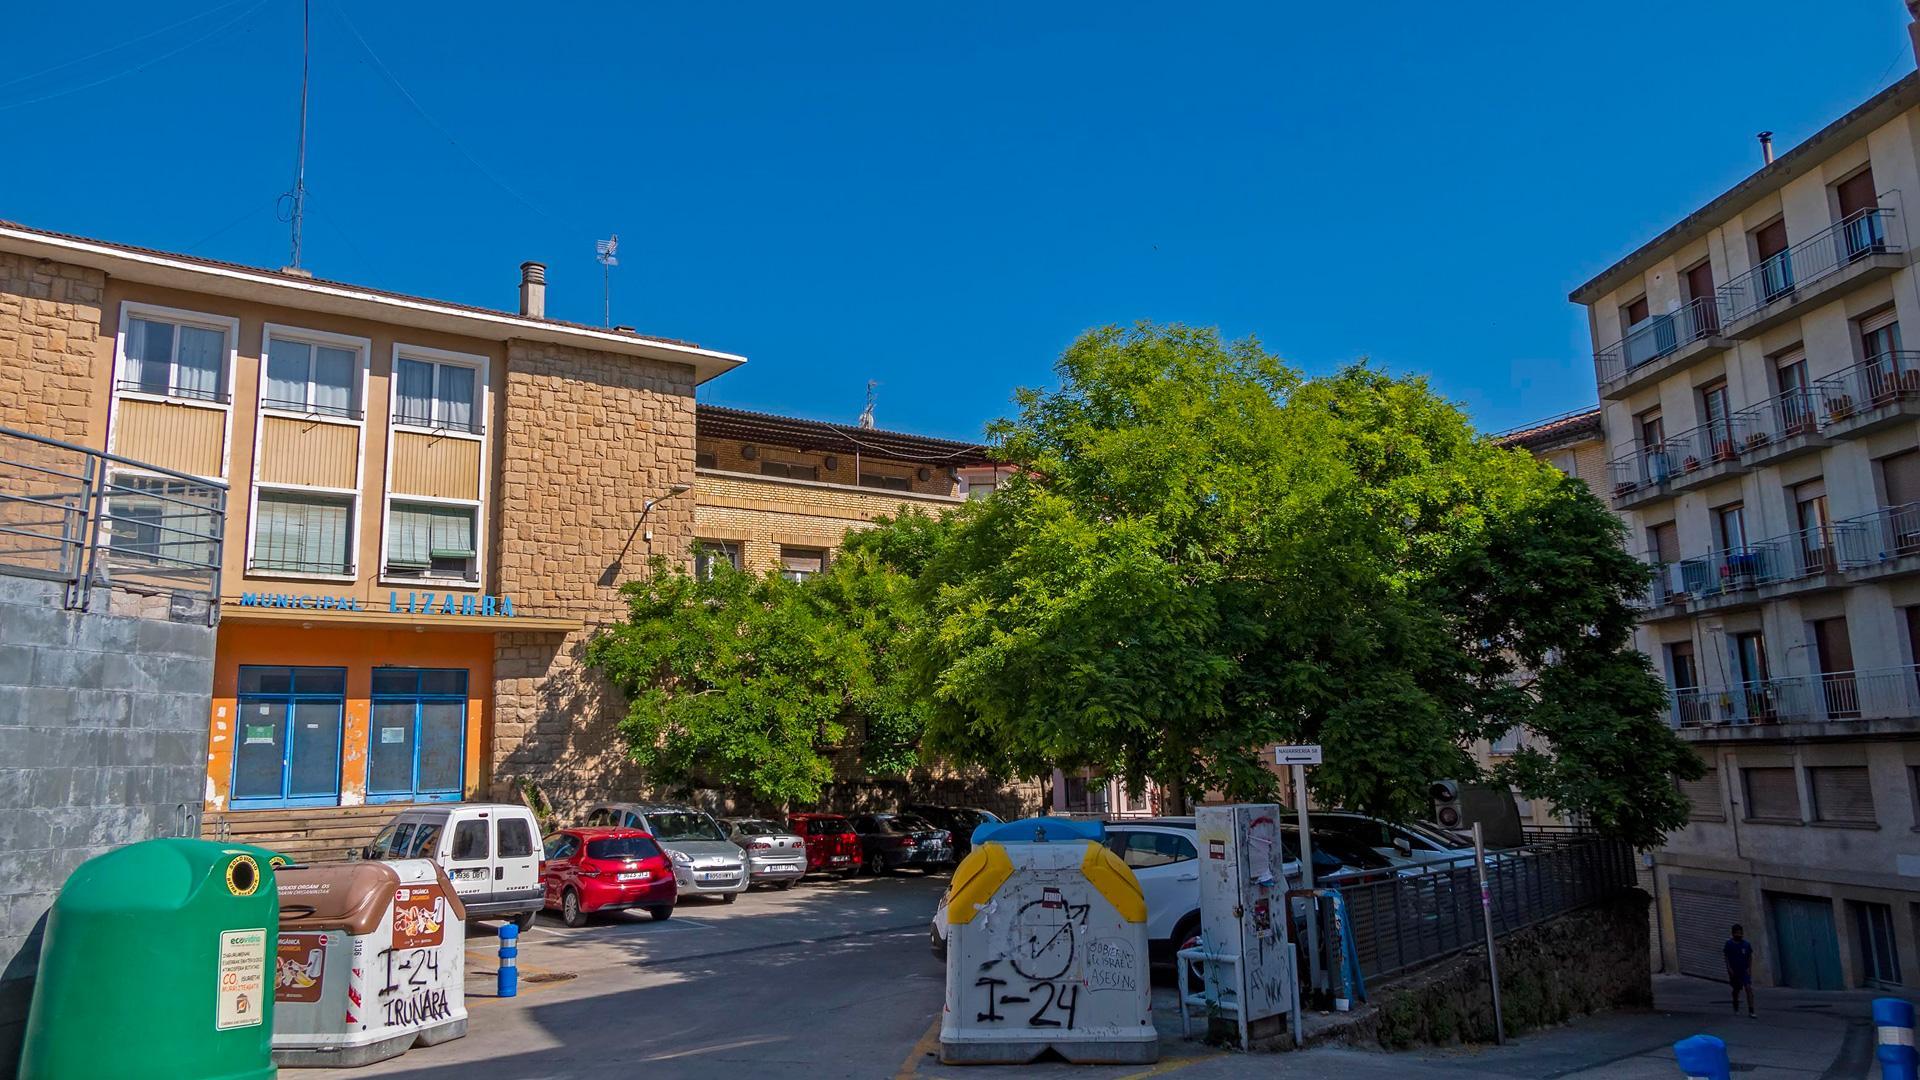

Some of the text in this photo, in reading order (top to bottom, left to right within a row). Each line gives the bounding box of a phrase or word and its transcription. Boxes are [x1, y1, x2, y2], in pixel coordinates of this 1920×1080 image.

[241, 591, 515, 618] MUNICIPAL LIZARRA
[230, 856, 243, 869] SOLO
[354, 939, 363, 956] 3136
[377, 945, 439, 997] I-24
[383, 986, 452, 1027] IRUÑARA
[975, 976, 1078, 1031] I-24
